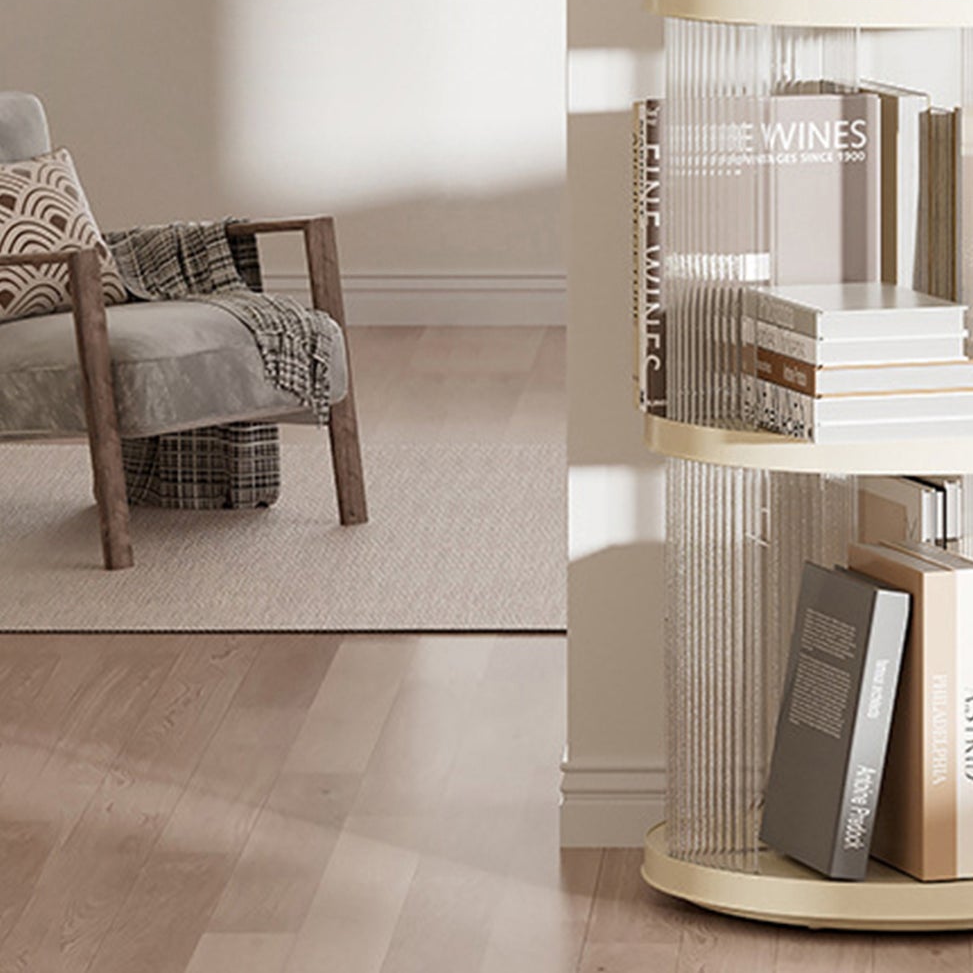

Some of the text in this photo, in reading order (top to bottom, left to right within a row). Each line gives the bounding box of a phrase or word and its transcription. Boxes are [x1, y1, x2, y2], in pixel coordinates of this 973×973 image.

[760, 119, 867, 151] WINES
[800, 152, 833, 163] SINCE
[837, 150, 866, 163] 1900
[646, 143, 661, 227] FINE
[646, 243, 661, 372] WINES
[931, 674, 949, 786] PHILADELPHIA
